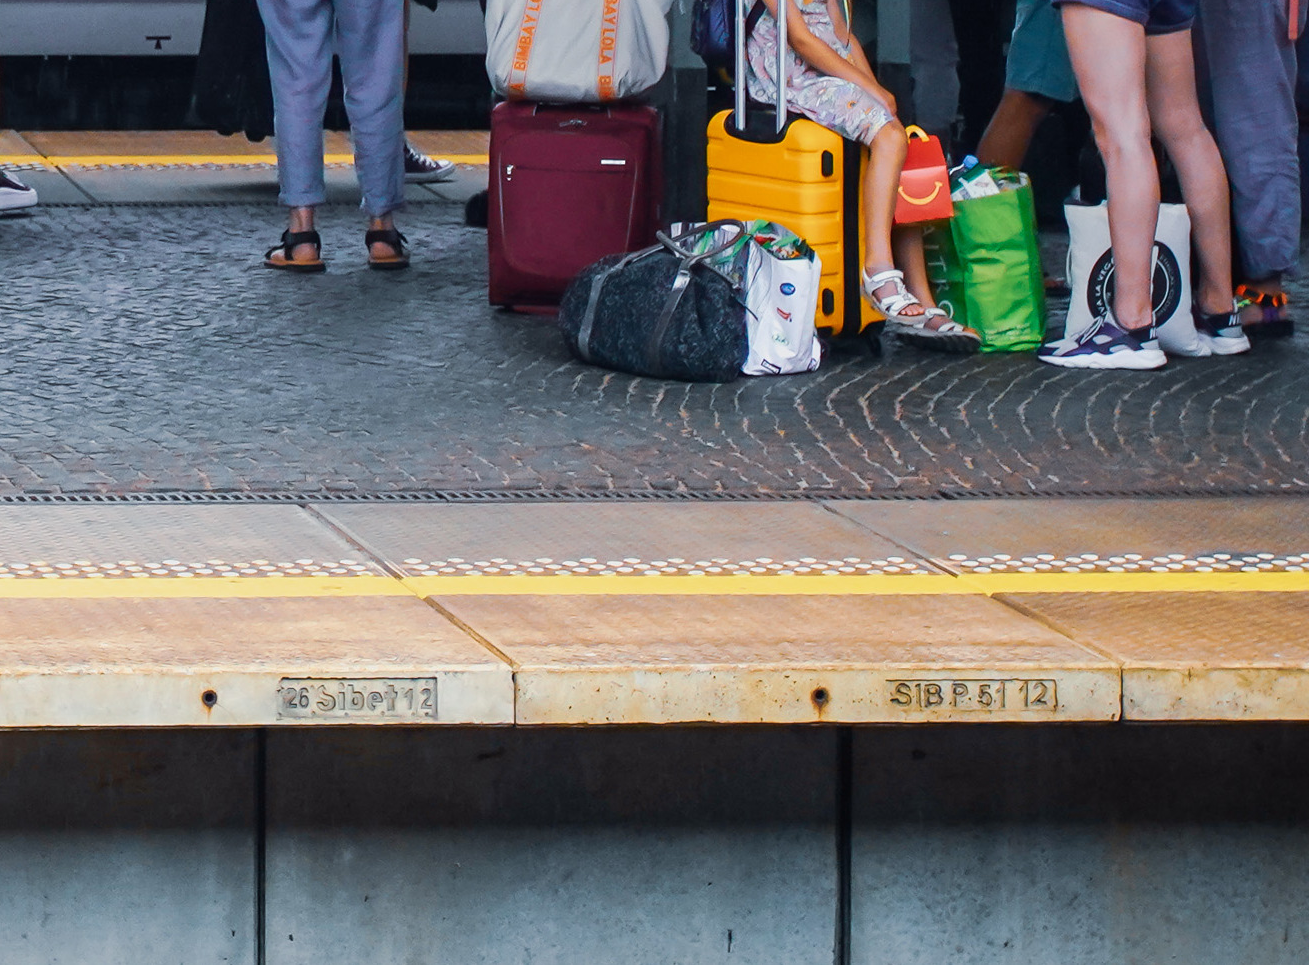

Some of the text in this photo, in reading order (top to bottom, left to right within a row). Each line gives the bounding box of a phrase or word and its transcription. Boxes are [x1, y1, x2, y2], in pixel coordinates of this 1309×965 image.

[282, 682, 433, 712] 26 Sibet 12
[1018, 681, 1048, 707] 12
